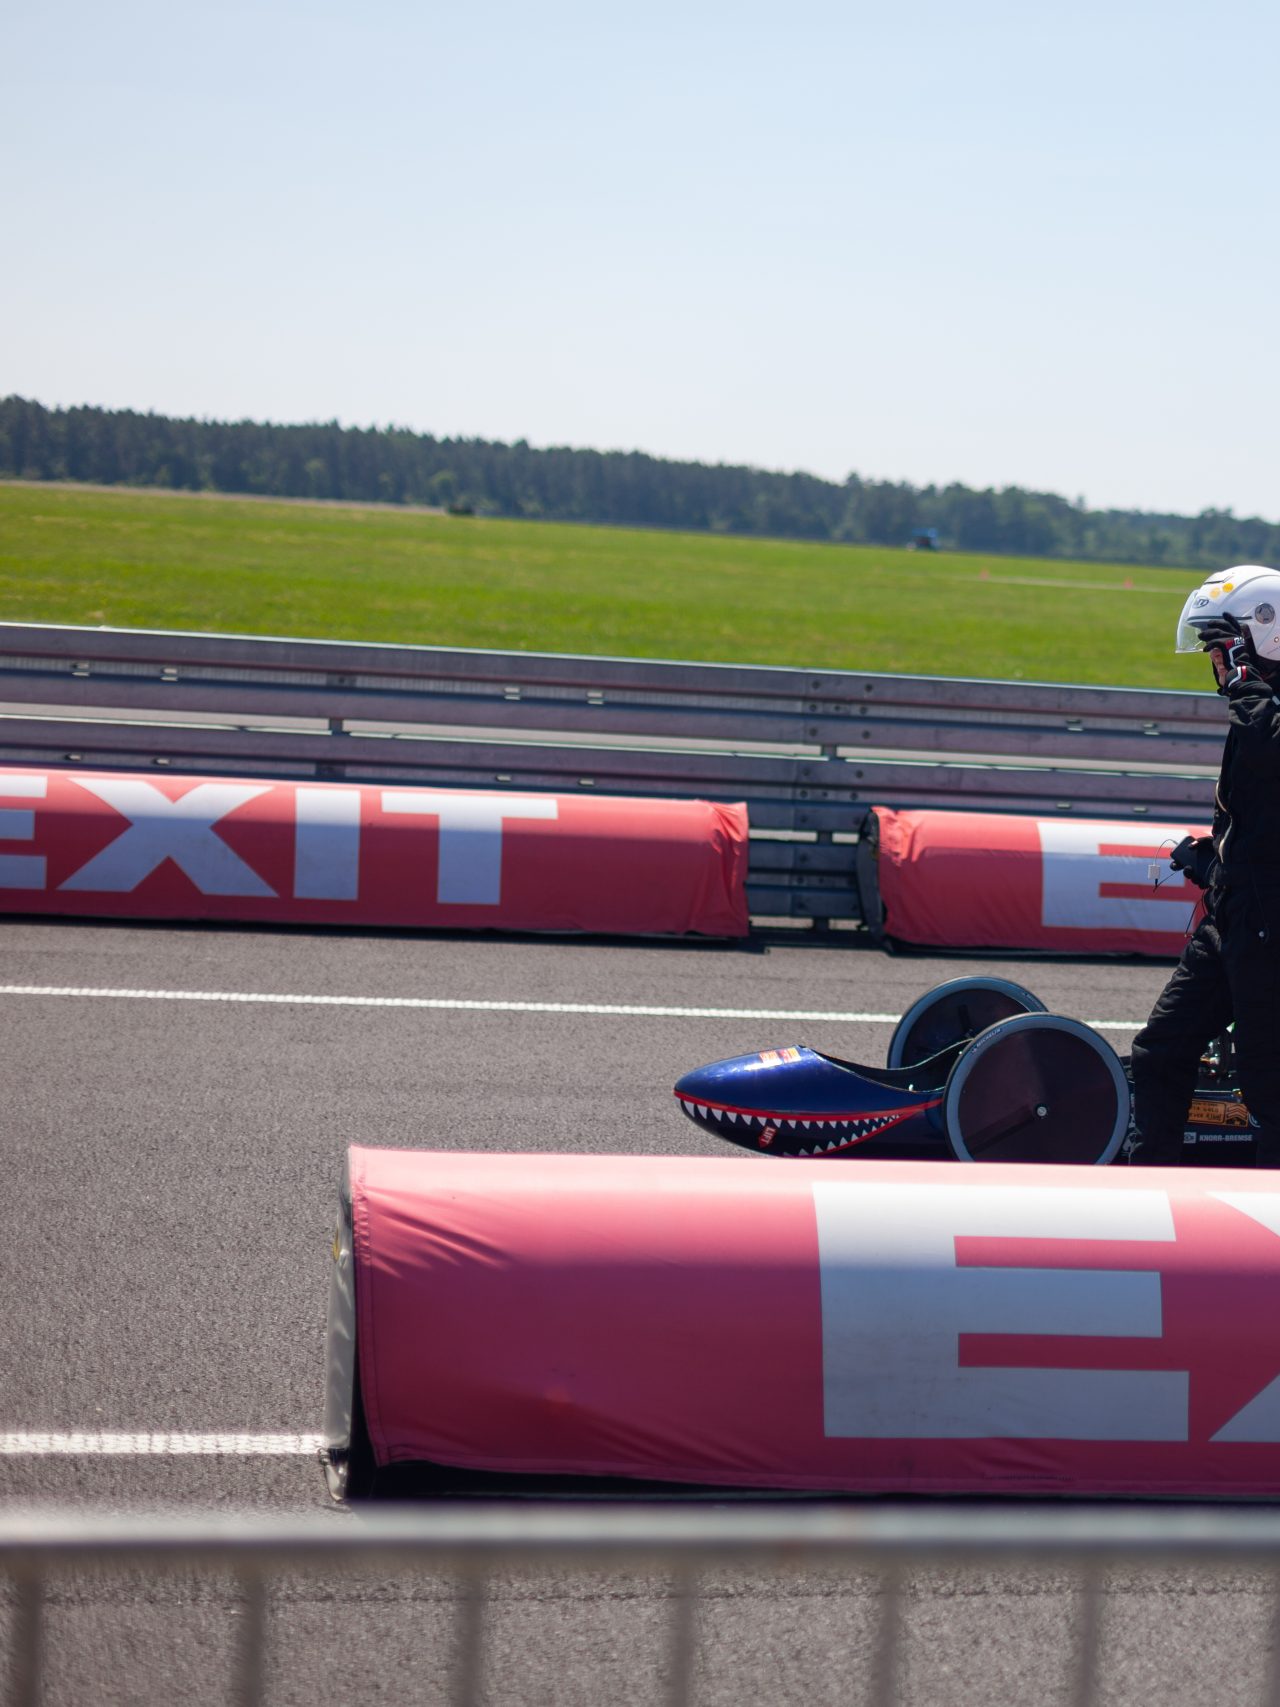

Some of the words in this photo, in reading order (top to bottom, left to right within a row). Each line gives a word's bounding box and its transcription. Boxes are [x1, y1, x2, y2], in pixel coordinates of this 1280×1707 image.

[0, 773, 558, 905] XIT
[761, 1126, 777, 1145] LIFT
[1199, 1134, 1253, 1142] KNORR-BREMSE
